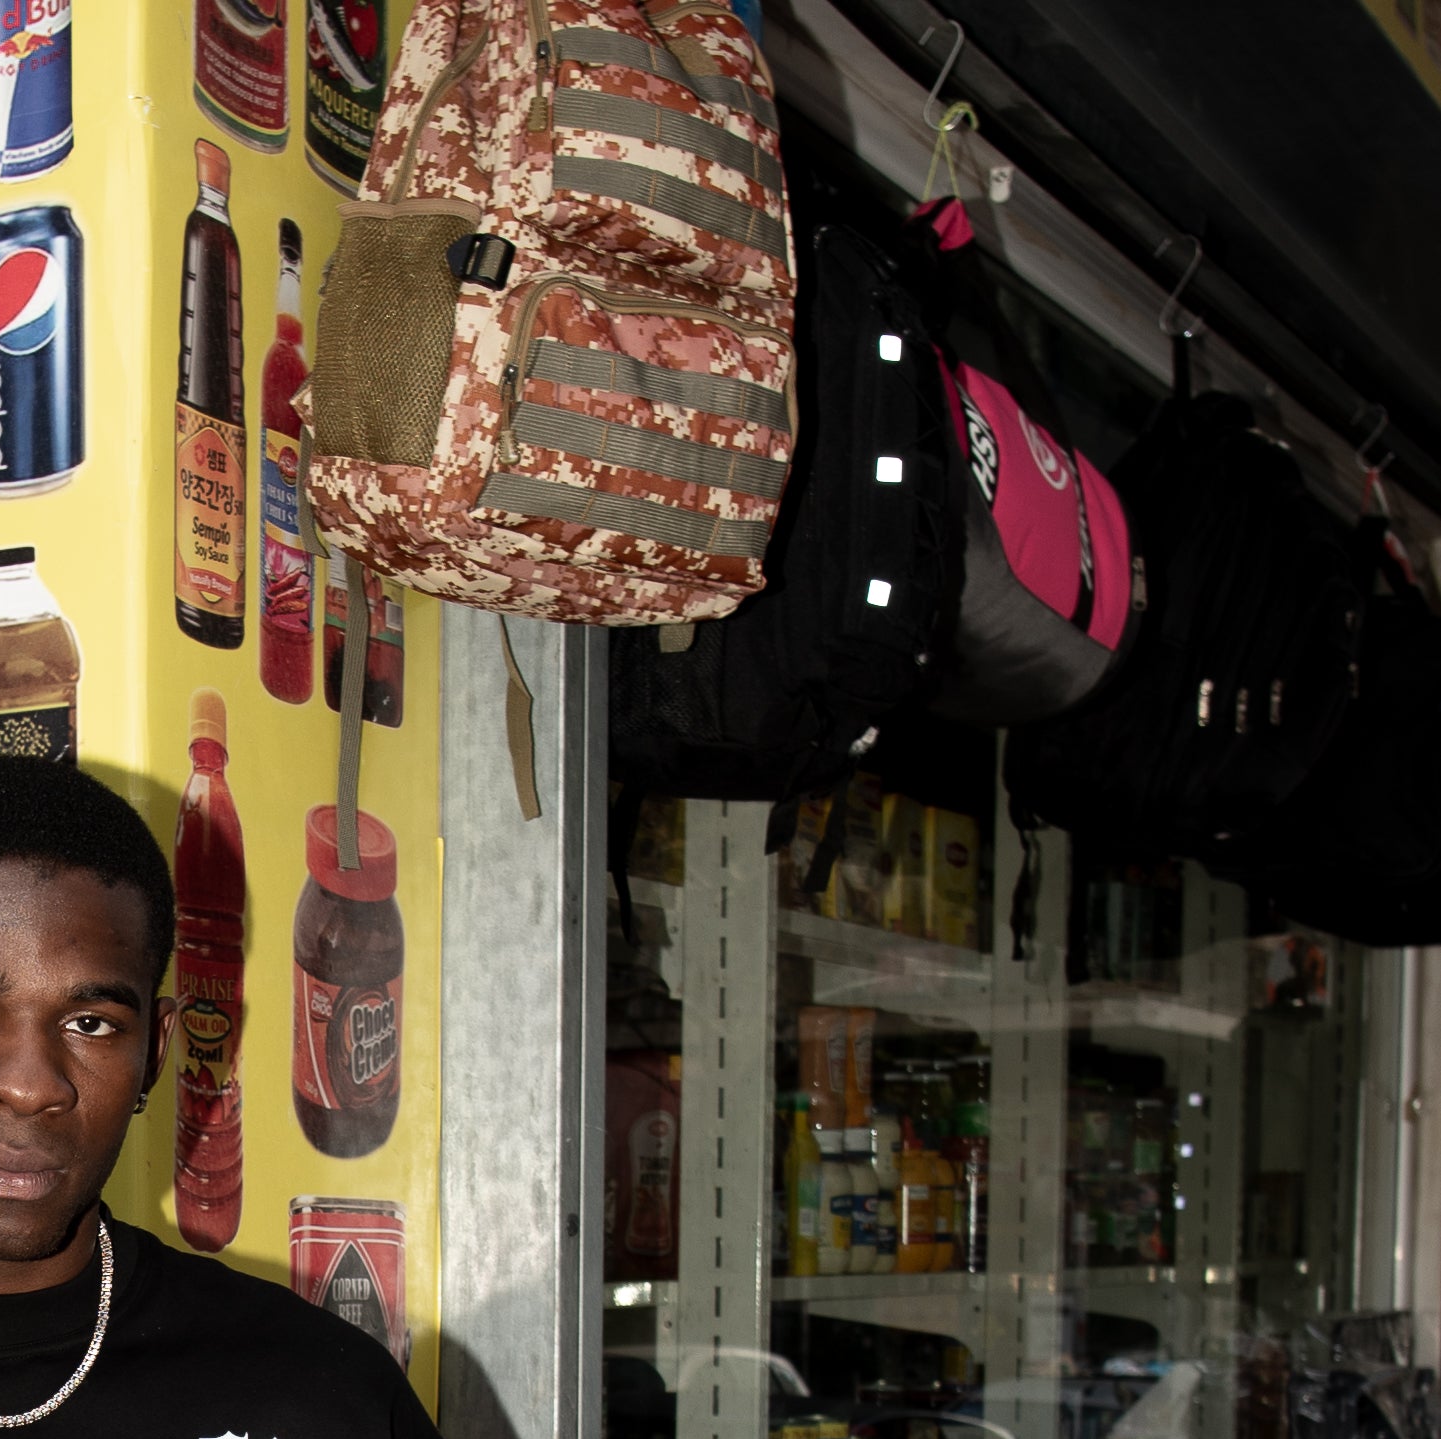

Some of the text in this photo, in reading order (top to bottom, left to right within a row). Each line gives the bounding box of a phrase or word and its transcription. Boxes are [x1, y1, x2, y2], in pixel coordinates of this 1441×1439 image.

[180, 467, 235, 516] 양조간장
[194, 541, 229, 564] Soy Sauce
[181, 973, 235, 1002] PRAISE
[184, 1012, 227, 1033] PALM OIL
[338, 1303, 363, 1325] BEEF
